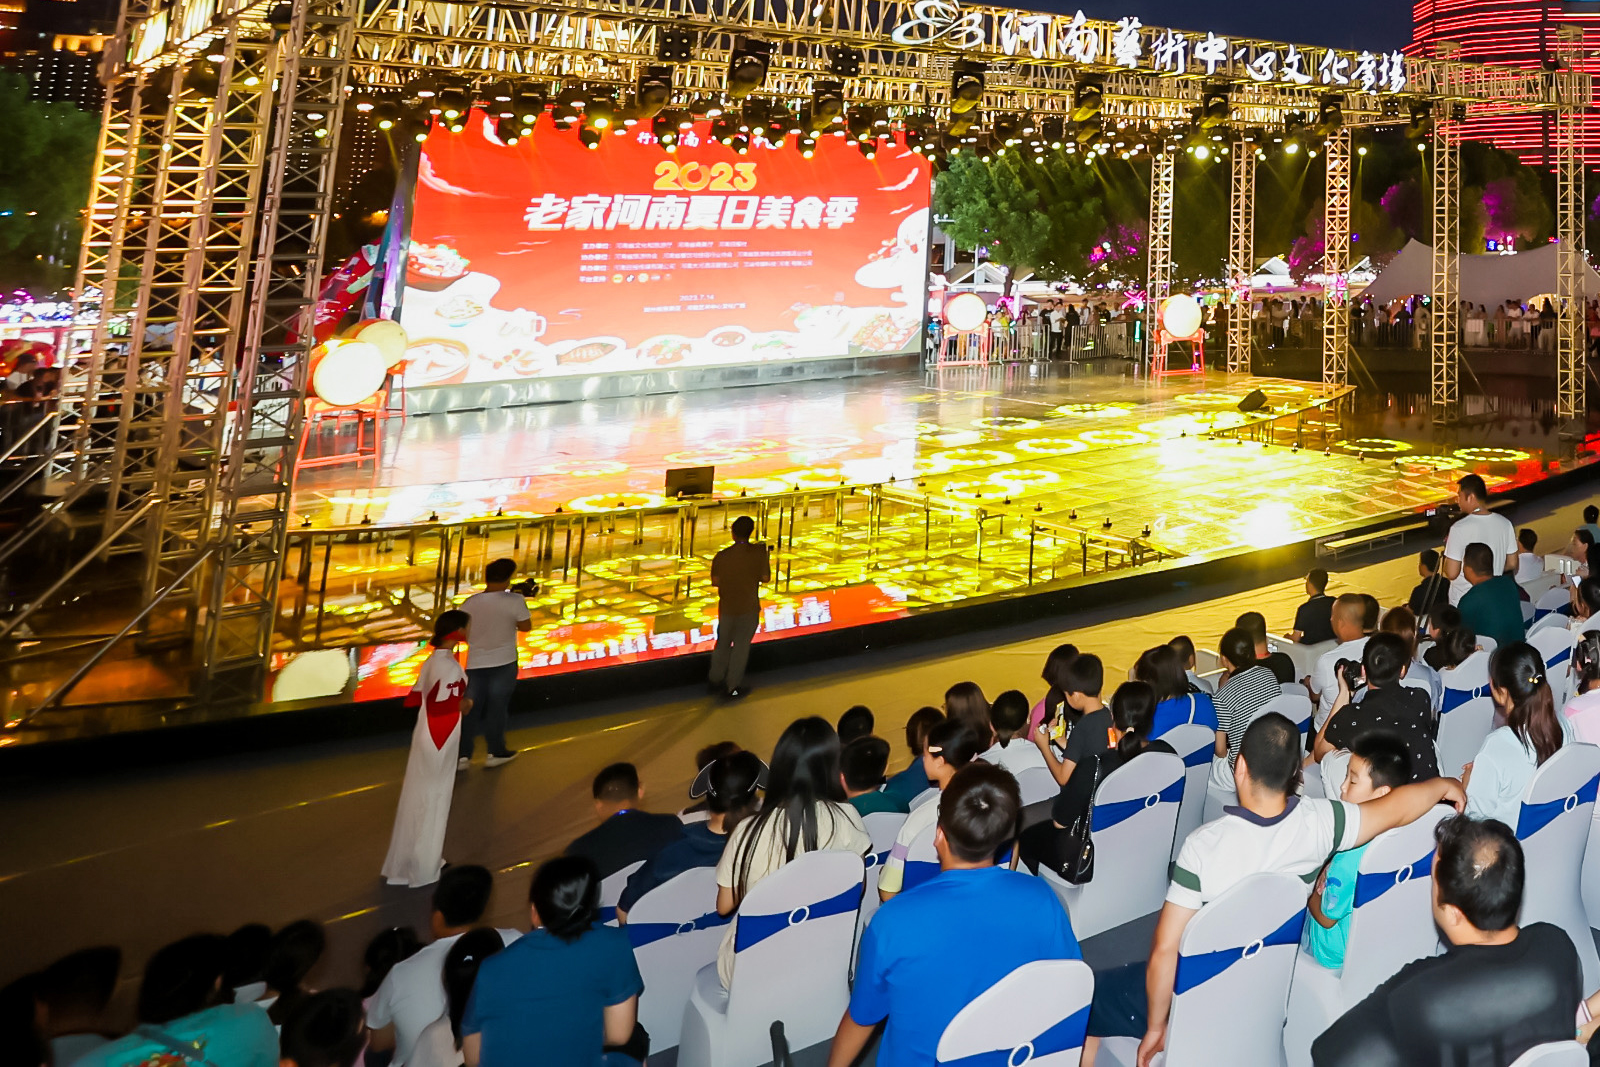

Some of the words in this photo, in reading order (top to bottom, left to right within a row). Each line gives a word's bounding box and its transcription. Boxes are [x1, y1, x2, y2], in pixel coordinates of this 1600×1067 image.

[653, 160, 757, 192] 2023
[523, 193, 859, 230] 老家河南夏日美食季
